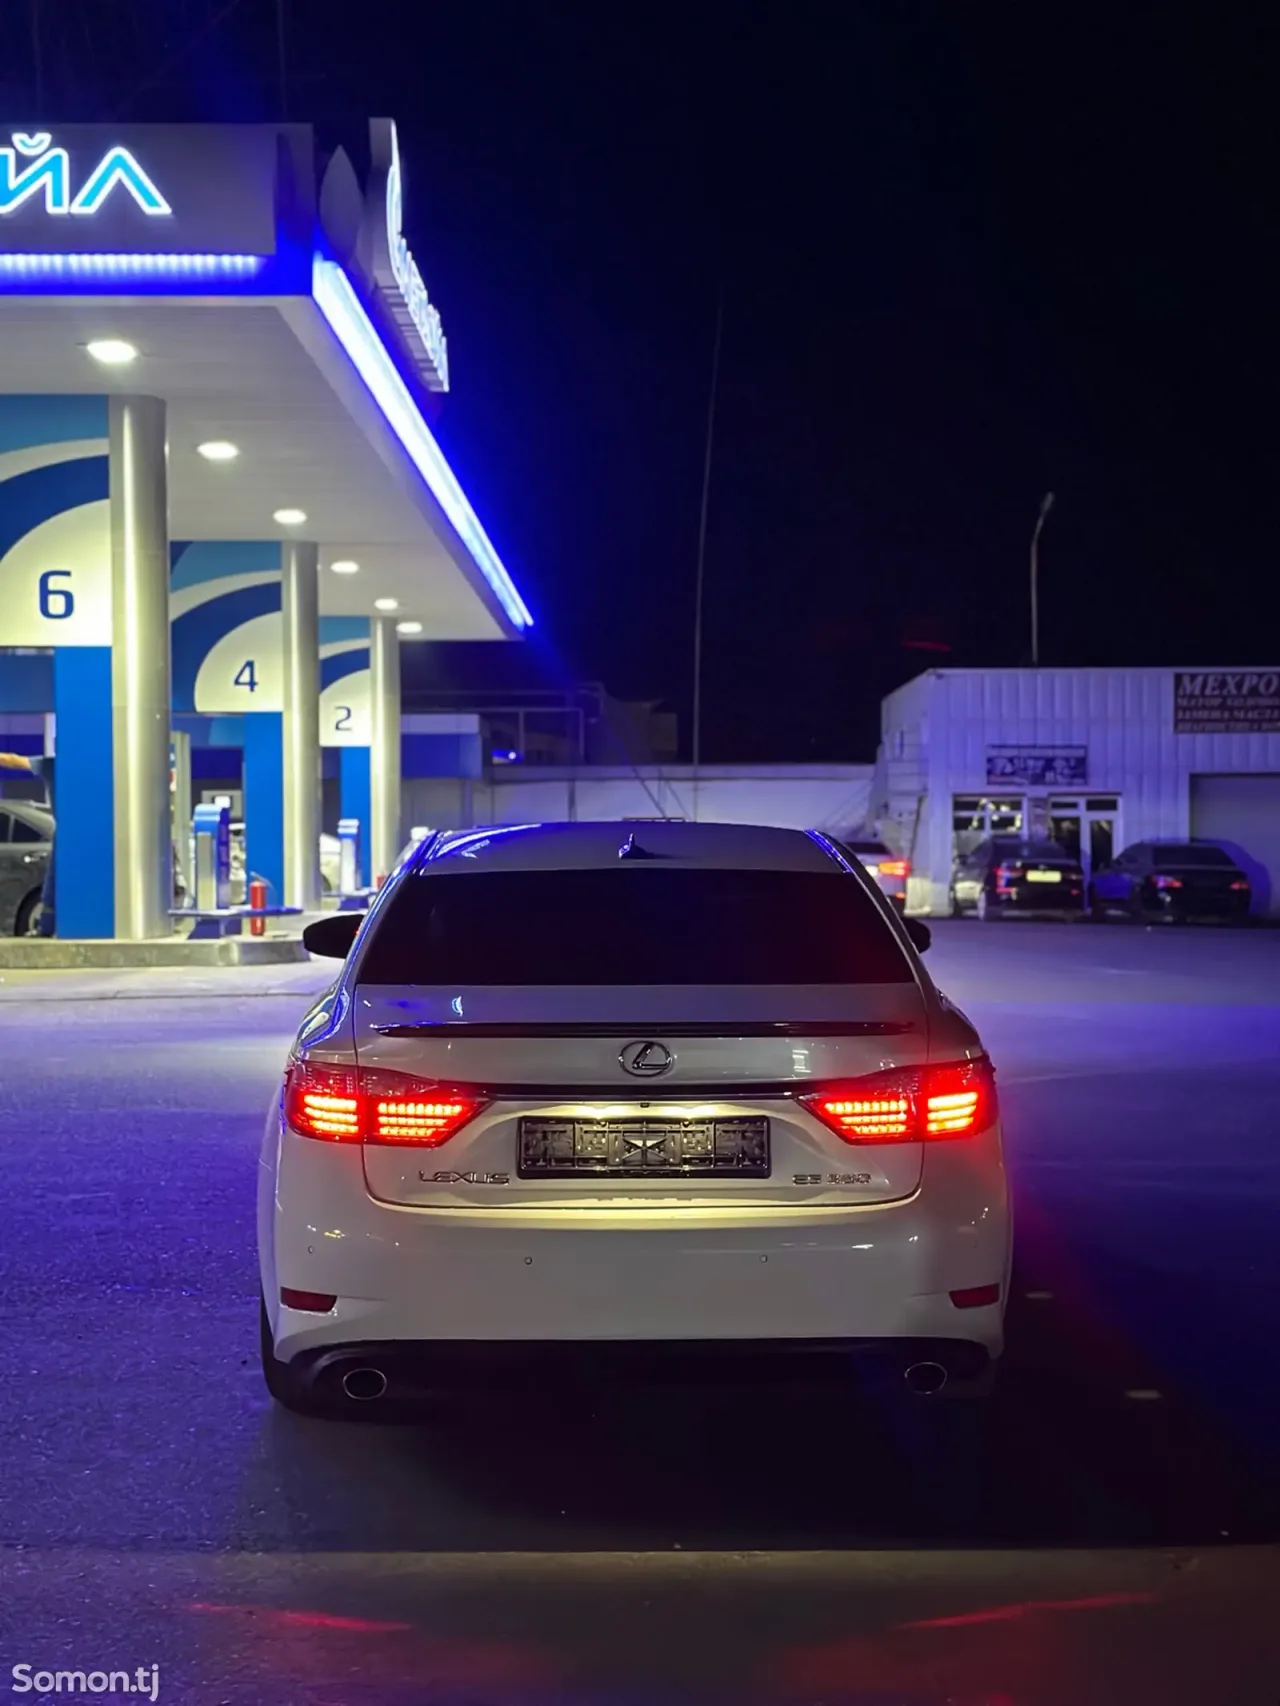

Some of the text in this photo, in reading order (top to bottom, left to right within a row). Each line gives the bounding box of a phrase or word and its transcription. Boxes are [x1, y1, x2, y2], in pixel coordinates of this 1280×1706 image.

[39, 570, 74, 619] 6
[234, 660, 258, 692] 4
[335, 706, 352, 731] 2
[419, 1170, 509, 1185] LEXUS
